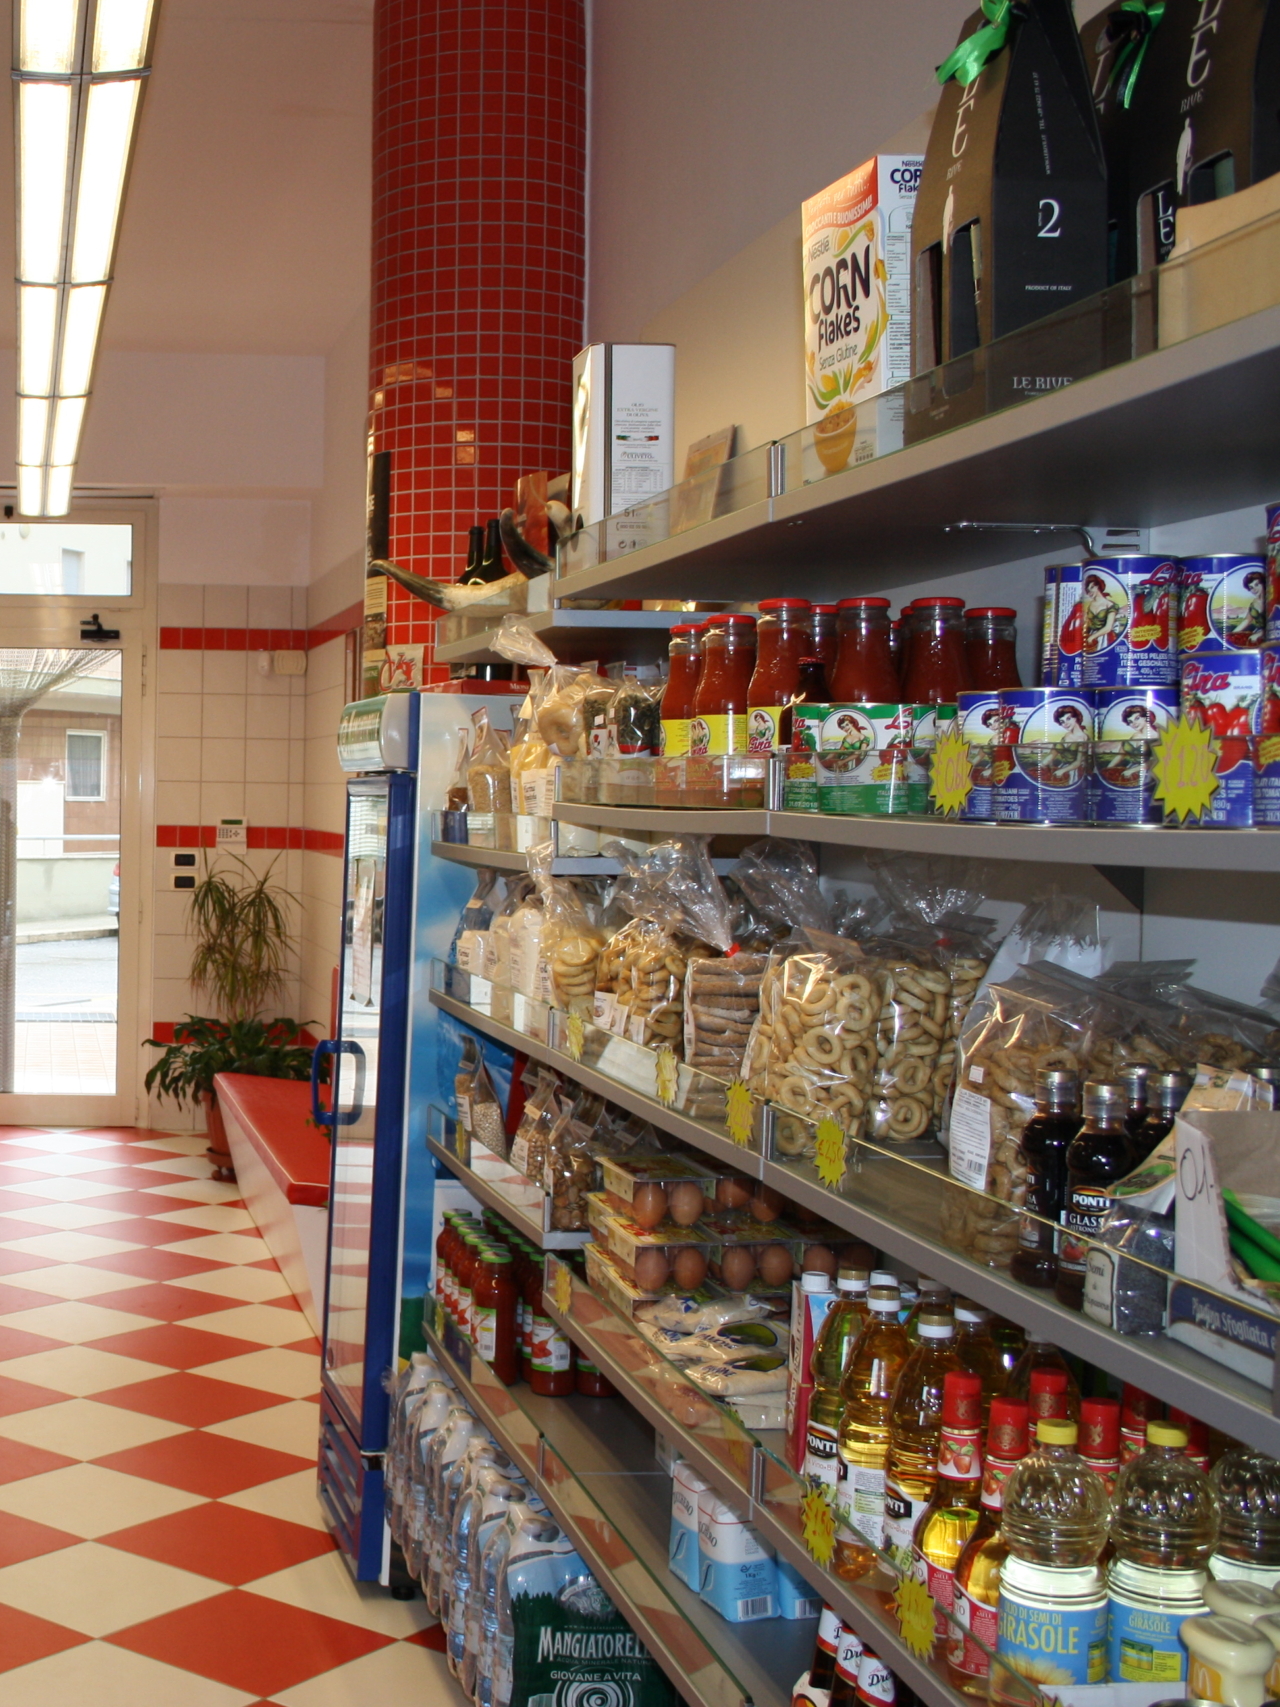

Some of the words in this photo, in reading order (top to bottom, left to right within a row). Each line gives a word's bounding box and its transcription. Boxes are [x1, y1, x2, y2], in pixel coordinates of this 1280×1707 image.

[1180, 89, 1204, 113] RIVE
[890, 168, 922, 184] COR
[946, 160, 963, 181] RIVE
[898, 184, 920, 193] flak
[806, 212, 833, 235] CROCCANTI
[1037, 199, 1061, 237] 2
[809, 244, 871, 324] CORN
[818, 305, 861, 354] flakes
[819, 354, 835, 371] Senza
[835, 344, 858, 362] Glutine
[1013, 376, 1032, 389] LE
[1035, 376, 1073, 389] RIVE
[1072, 1193, 1111, 1208] PONTI
[1070, 1213, 1105, 1228] GLASS
[1087, 1257, 1105, 1277] Semi
[1221, 1312, 1269, 1349] Sfogliata
[886, 1496, 905, 1514] NTI
[933, 1572, 949, 1580] MELE
[976, 1611, 993, 1619] MELE
[1005, 1601, 1018, 1617] OLIO
[1019, 1607, 1027, 1621] DI
[1029, 1611, 1050, 1625] SEMI
[1052, 1613, 1063, 1626] DI
[999, 1612, 1081, 1655] GIRASOLE
[1129, 1616, 1171, 1634] GIRASOLE
[537, 1626, 652, 1663] MANGIATOREL
[557, 1656, 580, 1665] ACQUA
[581, 1658, 618, 1666] MINERALE
[620, 1658, 653, 1666] NATUR
[550, 1670, 601, 1681] GIOVANE
[603, 1672, 612, 1681] A
[613, 1672, 642, 1681] VITA
[868, 1673, 892, 1687] Dre
